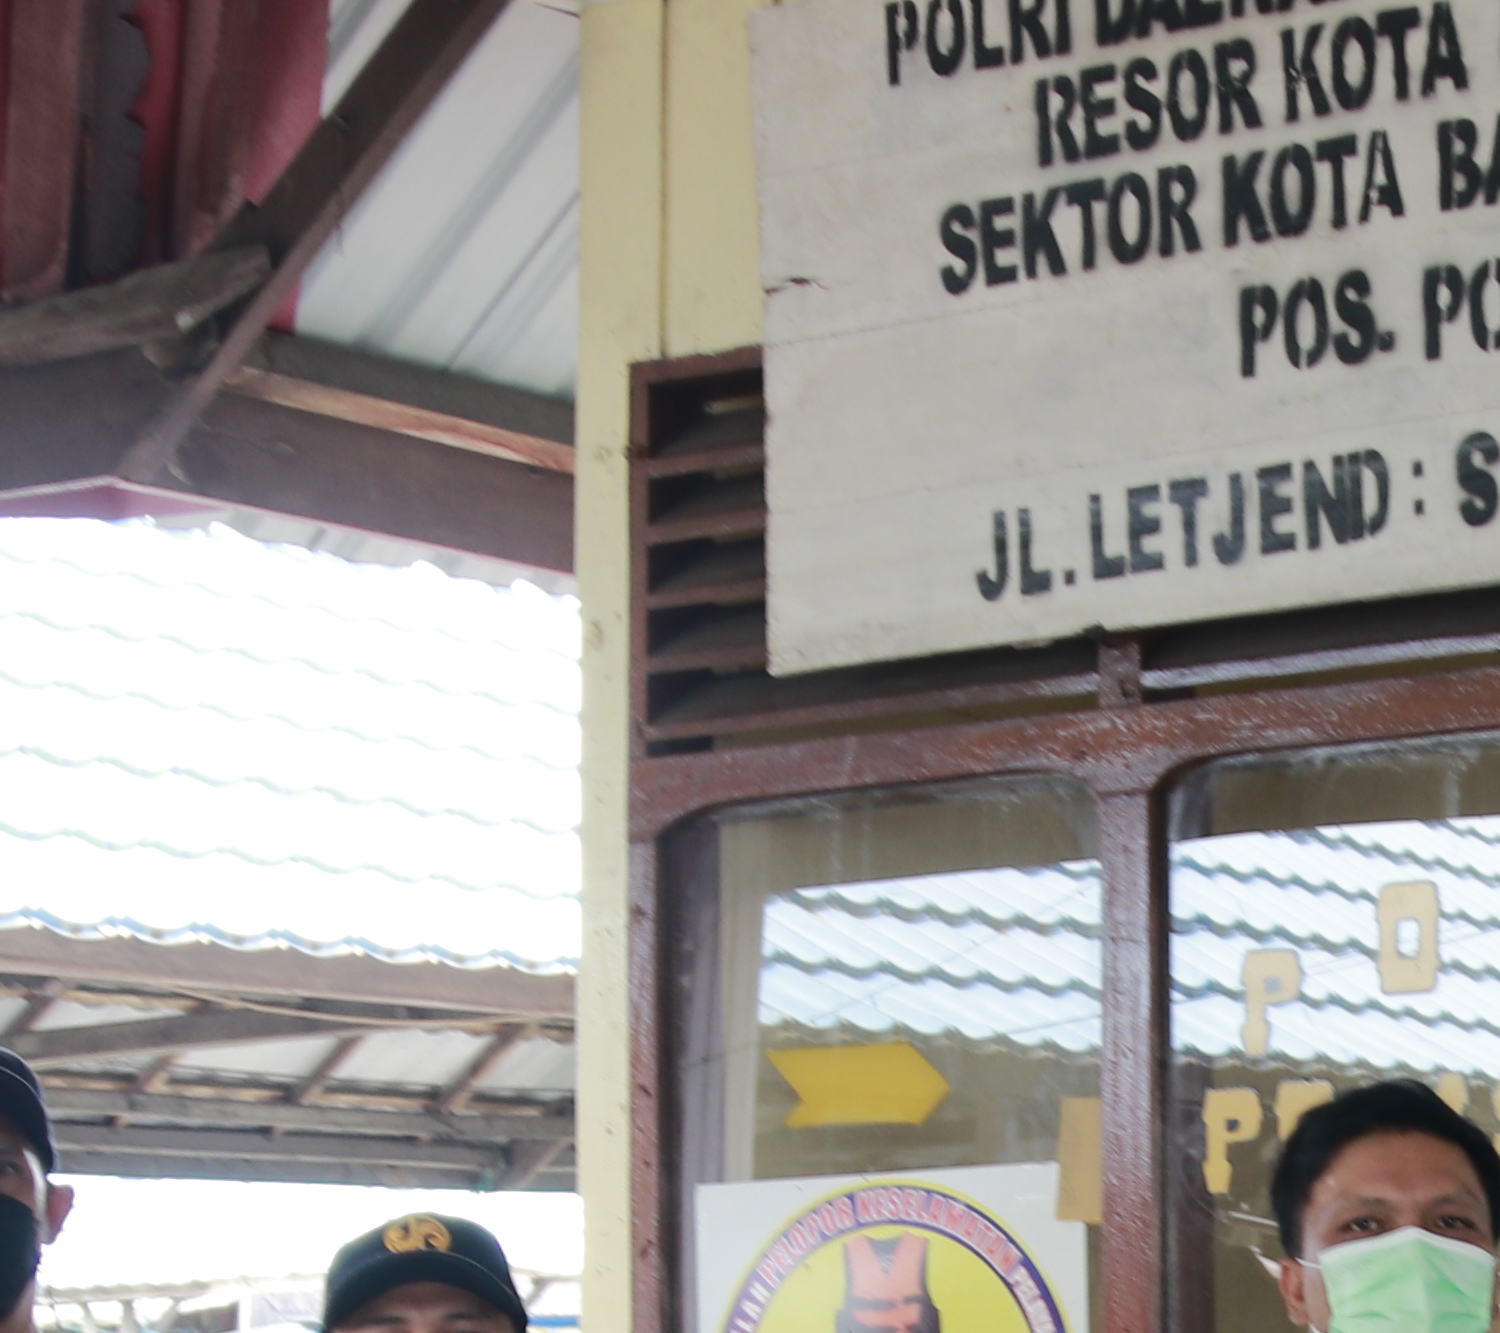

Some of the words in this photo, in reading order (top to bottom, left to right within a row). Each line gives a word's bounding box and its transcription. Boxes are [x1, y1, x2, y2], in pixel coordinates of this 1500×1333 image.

[886, 0, 1072, 86] POLRI
[1034, 38, 1263, 168] RESOR
[1280, 2, 1468, 123] KOTA
[940, 164, 1203, 295] SEKTOR
[1221, 130, 1405, 249] KOTA
[1240, 269, 1395, 378] POS.
[853, 1185, 1026, 1278] KESELAMATAN
